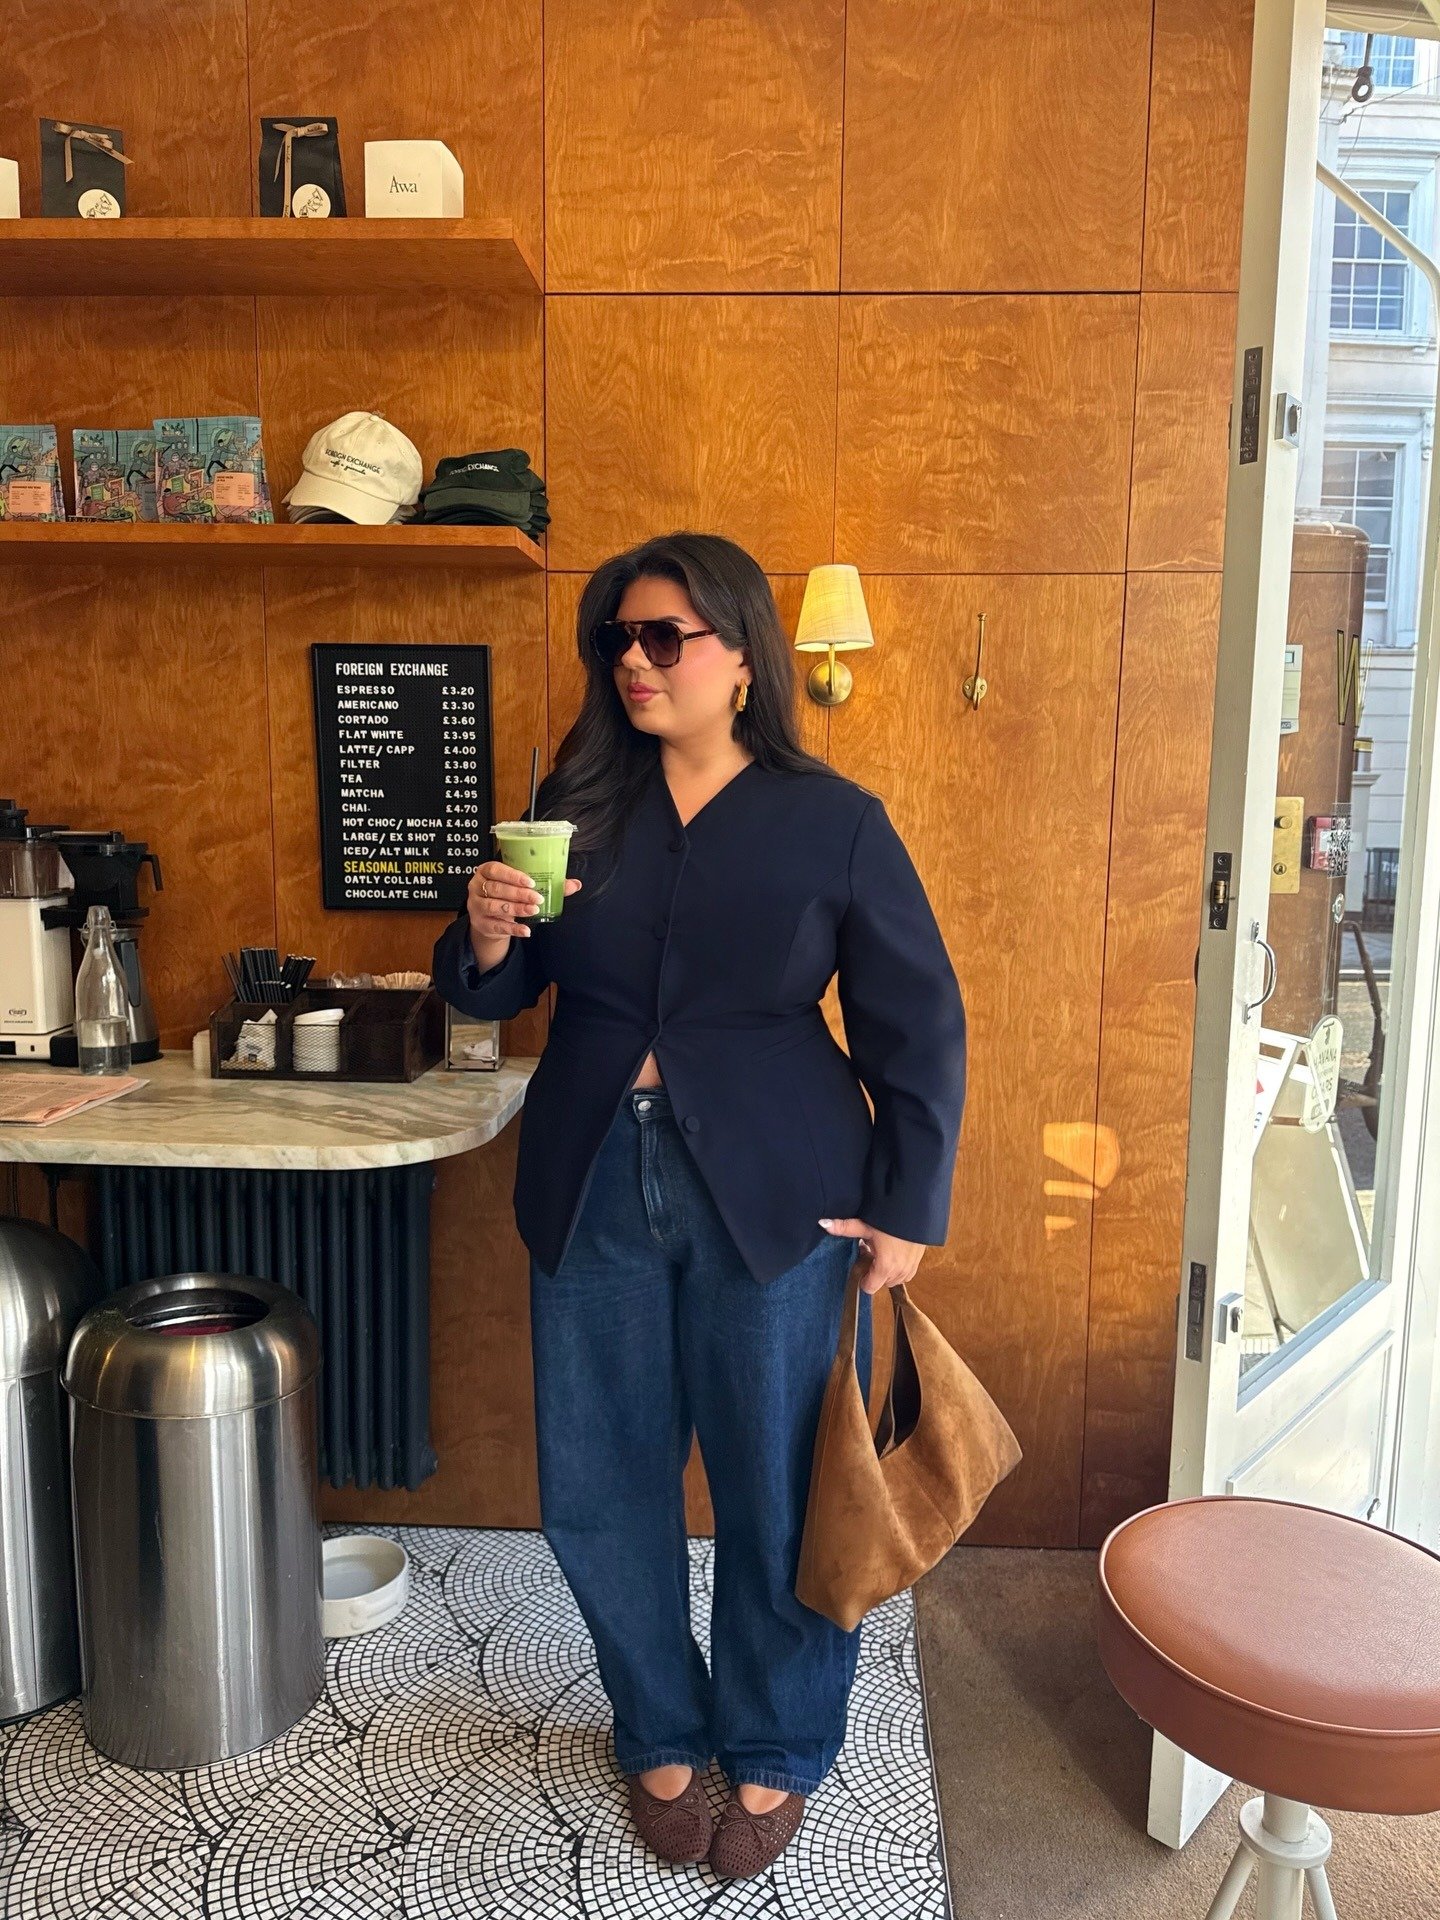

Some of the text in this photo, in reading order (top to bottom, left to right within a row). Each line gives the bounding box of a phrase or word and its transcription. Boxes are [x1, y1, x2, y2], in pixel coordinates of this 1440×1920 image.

[389, 175, 418, 194] Awa
[346, 455, 381, 475] EXCHANGE
[336, 663, 449, 676] FOREIGN EXCHANGE
[337, 685, 474, 695] ESPRESSO £3.20
[338, 701, 475, 710] AMERICANO £3.30
[338, 715, 475, 725] CORTADO £3.60
[339, 730, 476, 740] FLAT WHITE £3.95
[340, 745, 476, 757] LATTE/ CAPP £4.00
[340, 760, 476, 769] FILTER £3.80
[341, 774, 477, 784] TEA £3.40
[341, 789, 477, 798] MATCHA £4.95
[446, 805, 478, 813] £4.70
[343, 818, 478, 830] HOT CHOC/ MOCHA £4.60
[343, 833, 479, 844] LARGE/ EX SHOT £0.50
[344, 847, 479, 858] ICED/ ALT MILK £0.50
[344, 861, 401, 873] SEASONAL
[405, 862, 444, 873] DRINKS
[344, 876, 433, 884] OATLY COLLABS
[345, 890, 438, 898] CHOCOLATE CHAI
